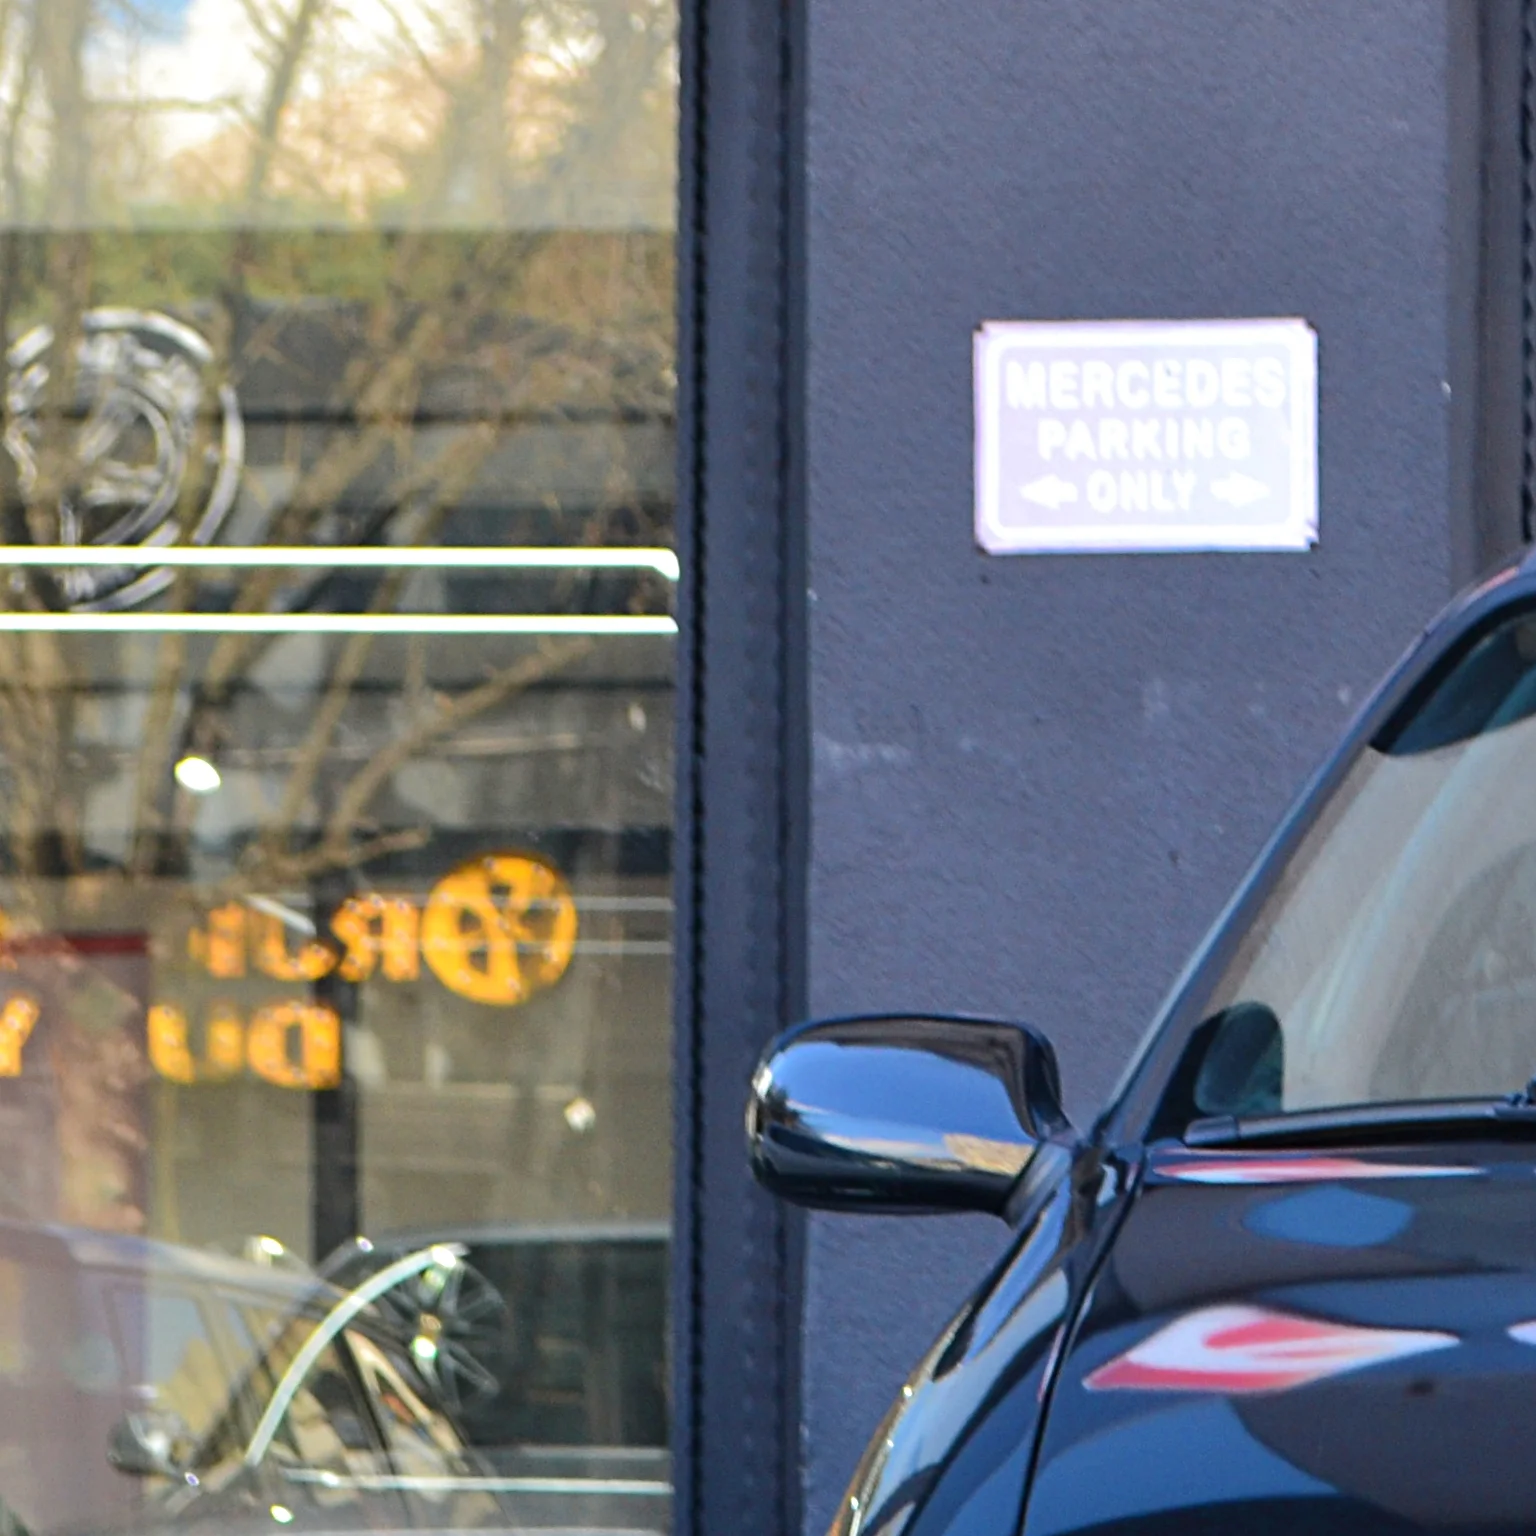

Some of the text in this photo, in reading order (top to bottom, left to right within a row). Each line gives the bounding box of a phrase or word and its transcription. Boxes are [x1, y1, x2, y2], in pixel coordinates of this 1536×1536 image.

[1006, 357, 1287, 410] MERCEDES
[1037, 417, 1250, 461] PARKING
[1087, 469, 1197, 513] ONLY
